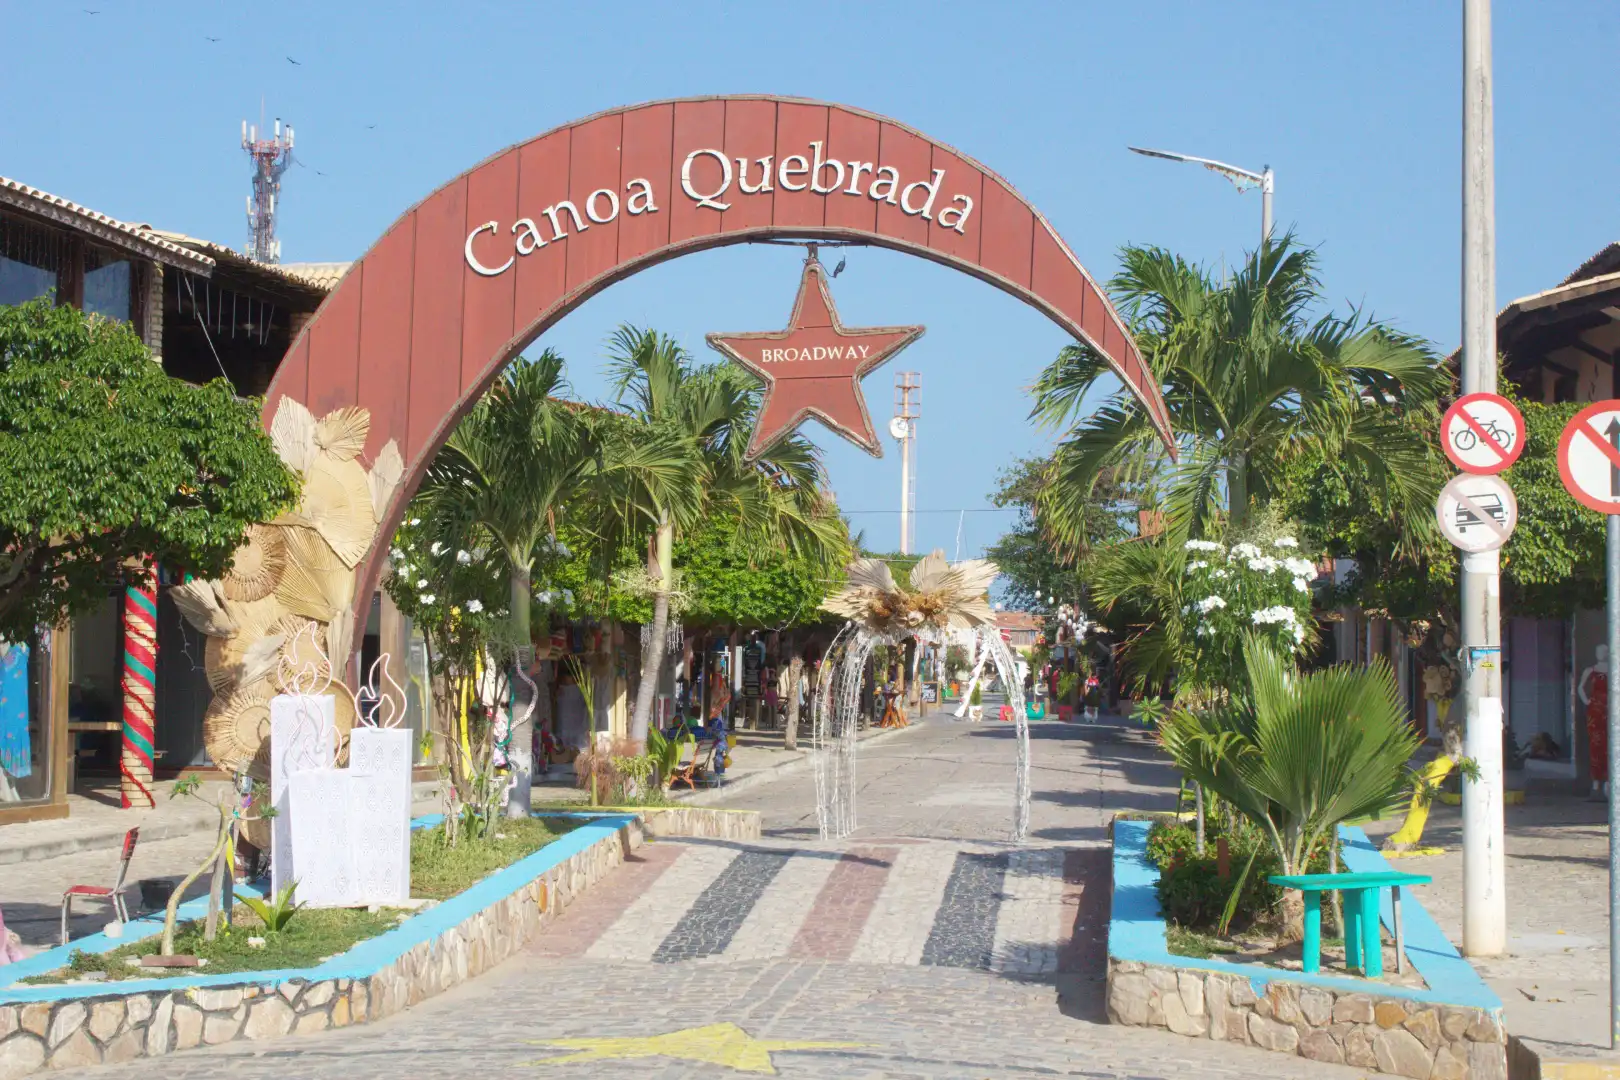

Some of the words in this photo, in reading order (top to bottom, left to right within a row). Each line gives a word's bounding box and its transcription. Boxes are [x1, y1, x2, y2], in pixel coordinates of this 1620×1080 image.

[464, 178, 658, 276] Canoa
[681, 141, 974, 233] Quebrada
[762, 345, 870, 363] BROADWAY
